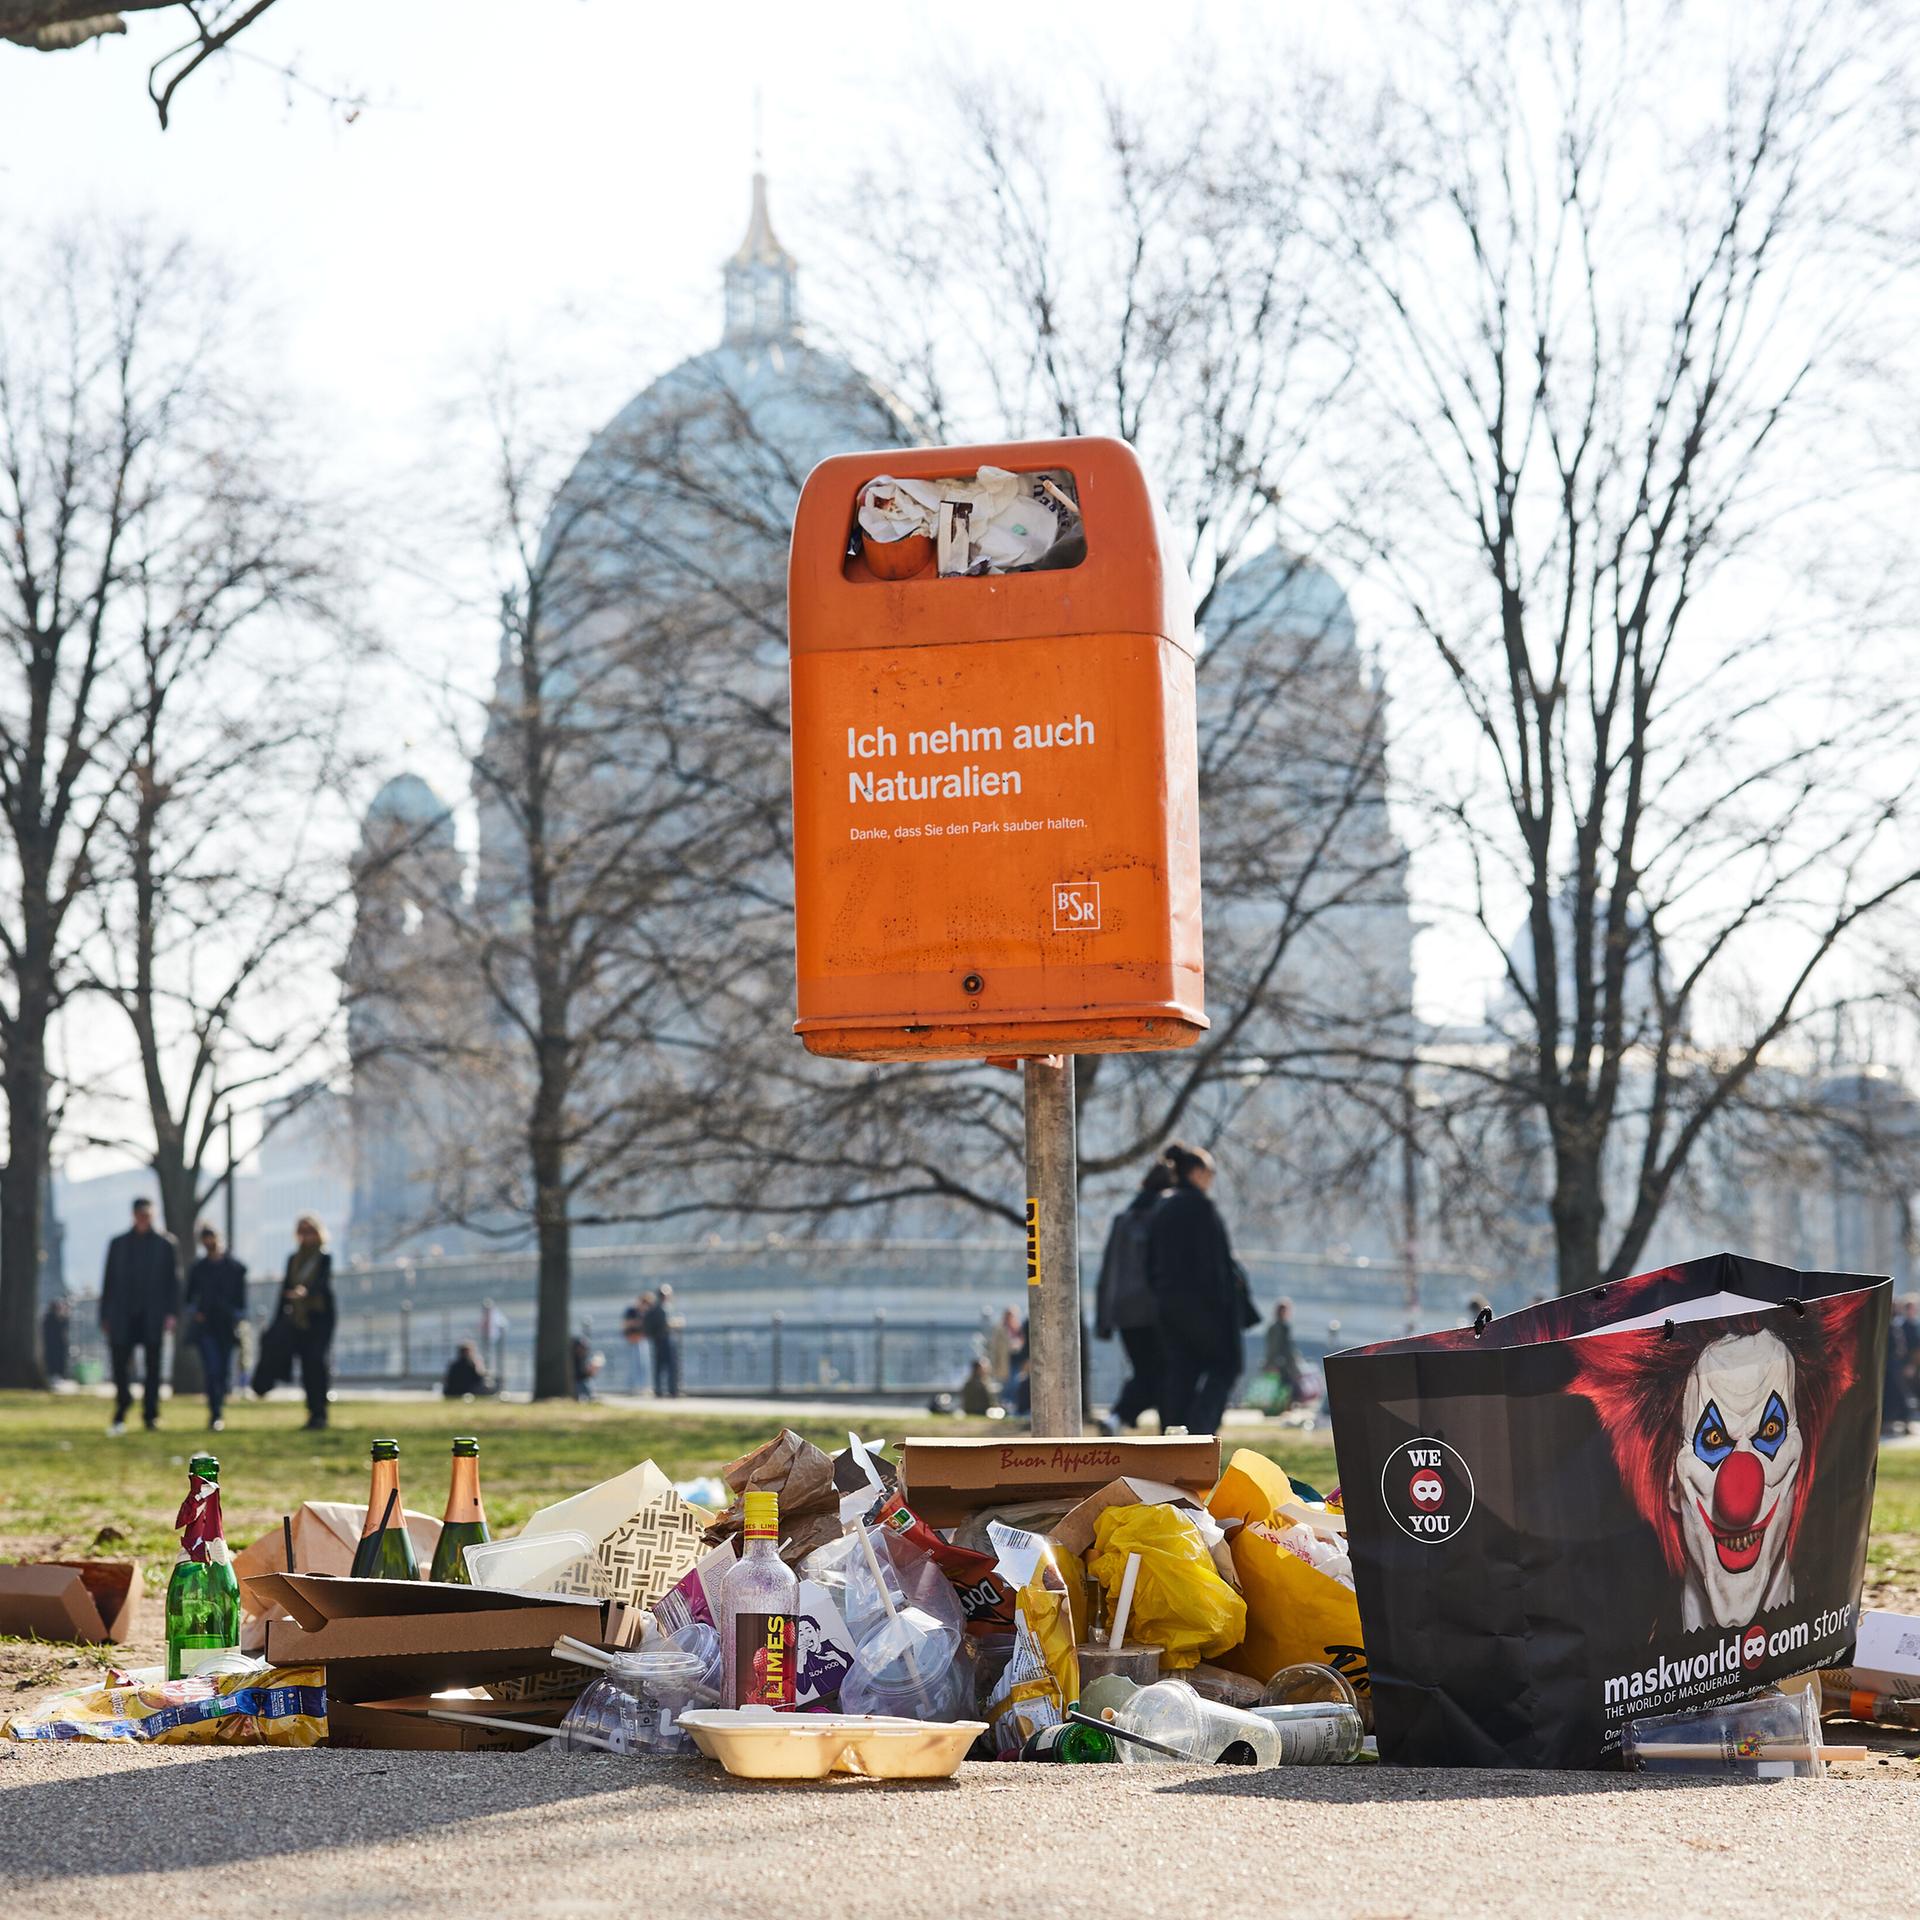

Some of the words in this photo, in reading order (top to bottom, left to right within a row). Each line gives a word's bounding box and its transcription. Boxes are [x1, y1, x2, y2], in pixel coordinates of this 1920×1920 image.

[848, 726, 897, 758] Ich
[909, 722, 1001, 755] nehm
[1013, 714, 1095, 749] auch
[848, 765, 1022, 803] Naturalien
[850, 826, 891, 841] Danke,
[894, 823, 921, 837] dass
[925, 822, 943, 836] Sie
[946, 821, 969, 835] den
[972, 819, 999, 833] Park
[1003, 818, 1044, 832] sauber
[1047, 815, 1088, 830] halten.
[1058, 892, 1095, 922] BSR
[1000, 1448, 1046, 1469] Buon
[1051, 1447, 1120, 1472] Appetito
[1408, 1450, 1441, 1467] WE
[1409, 1515, 1450, 1532] YOU
[1812, 1603, 1851, 1642] store
[766, 1615, 785, 1699] LIMES
[808, 1668, 823, 1677] SLOW
[824, 1660, 839, 1671] FOOD
[1605, 1703, 1625, 1720] THE
[1626, 1694, 1661, 1714] WORLD
[1664, 1690, 1676, 1704] OF
[1678, 1671, 1741, 1700] MASQUERADE
